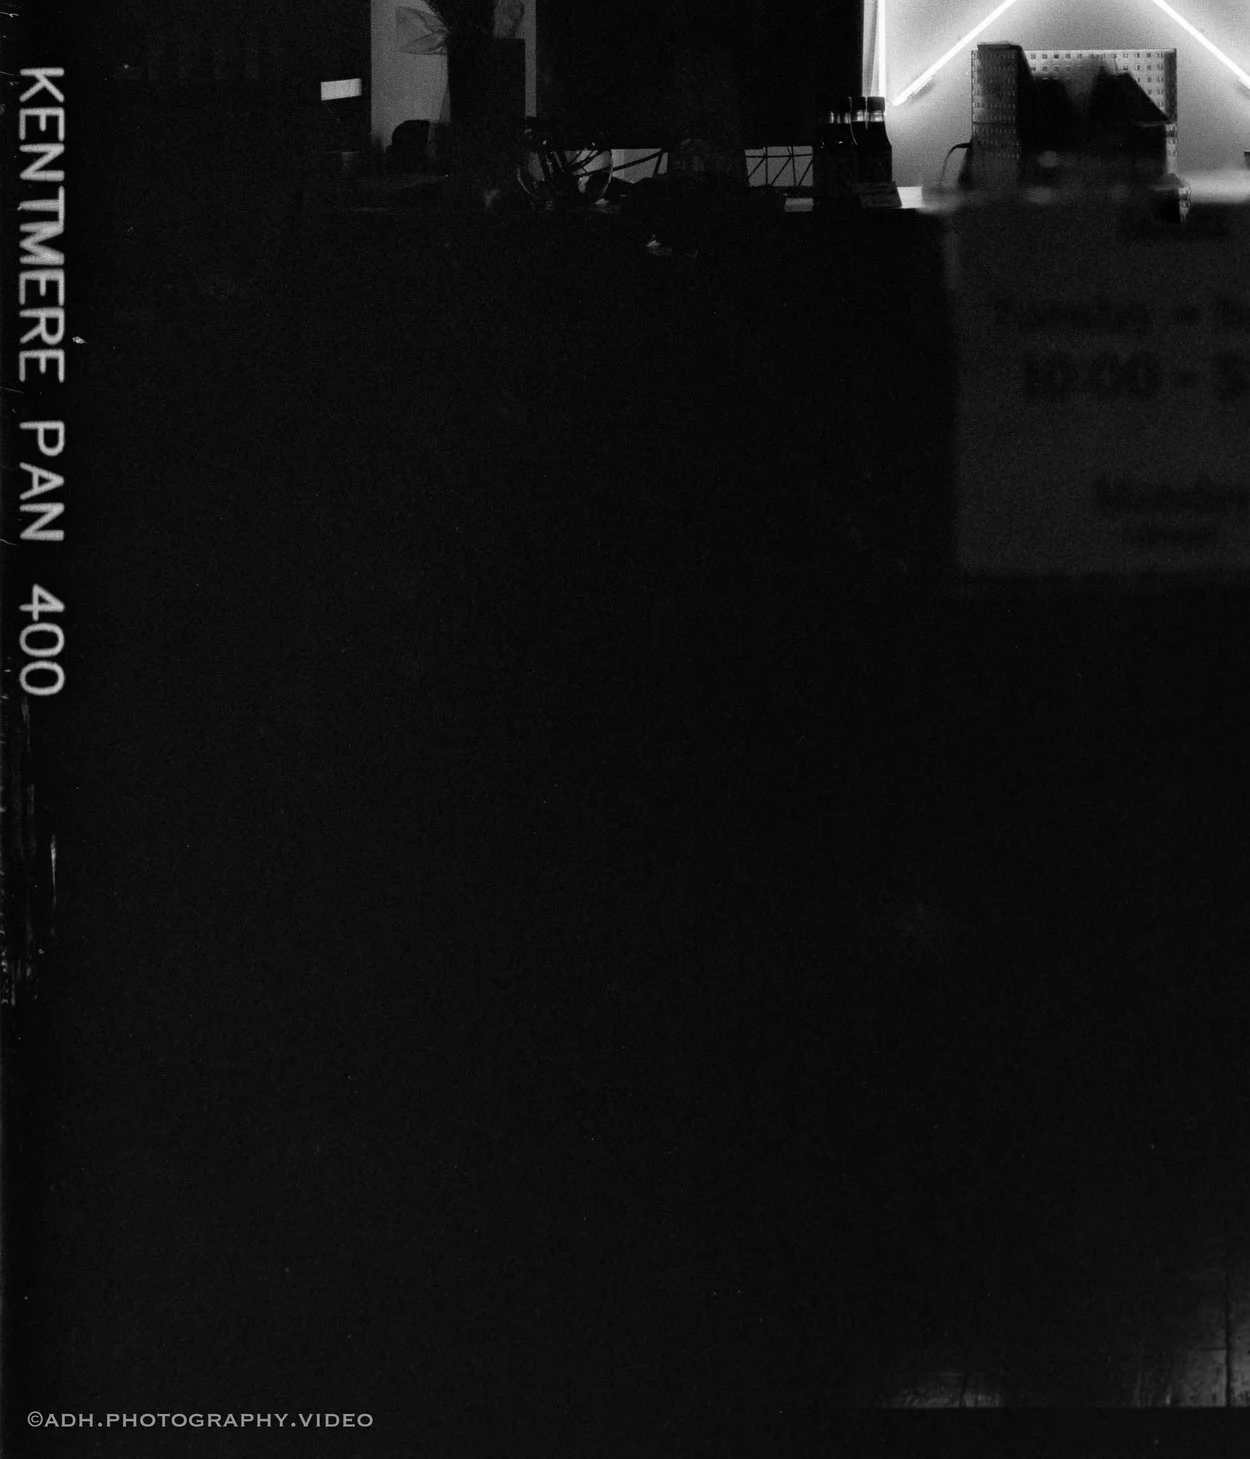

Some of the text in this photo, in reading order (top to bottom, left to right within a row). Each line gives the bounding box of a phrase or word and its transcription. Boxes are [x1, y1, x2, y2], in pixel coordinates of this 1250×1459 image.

[18, 67, 66, 697] KENTMERE PAN 400
